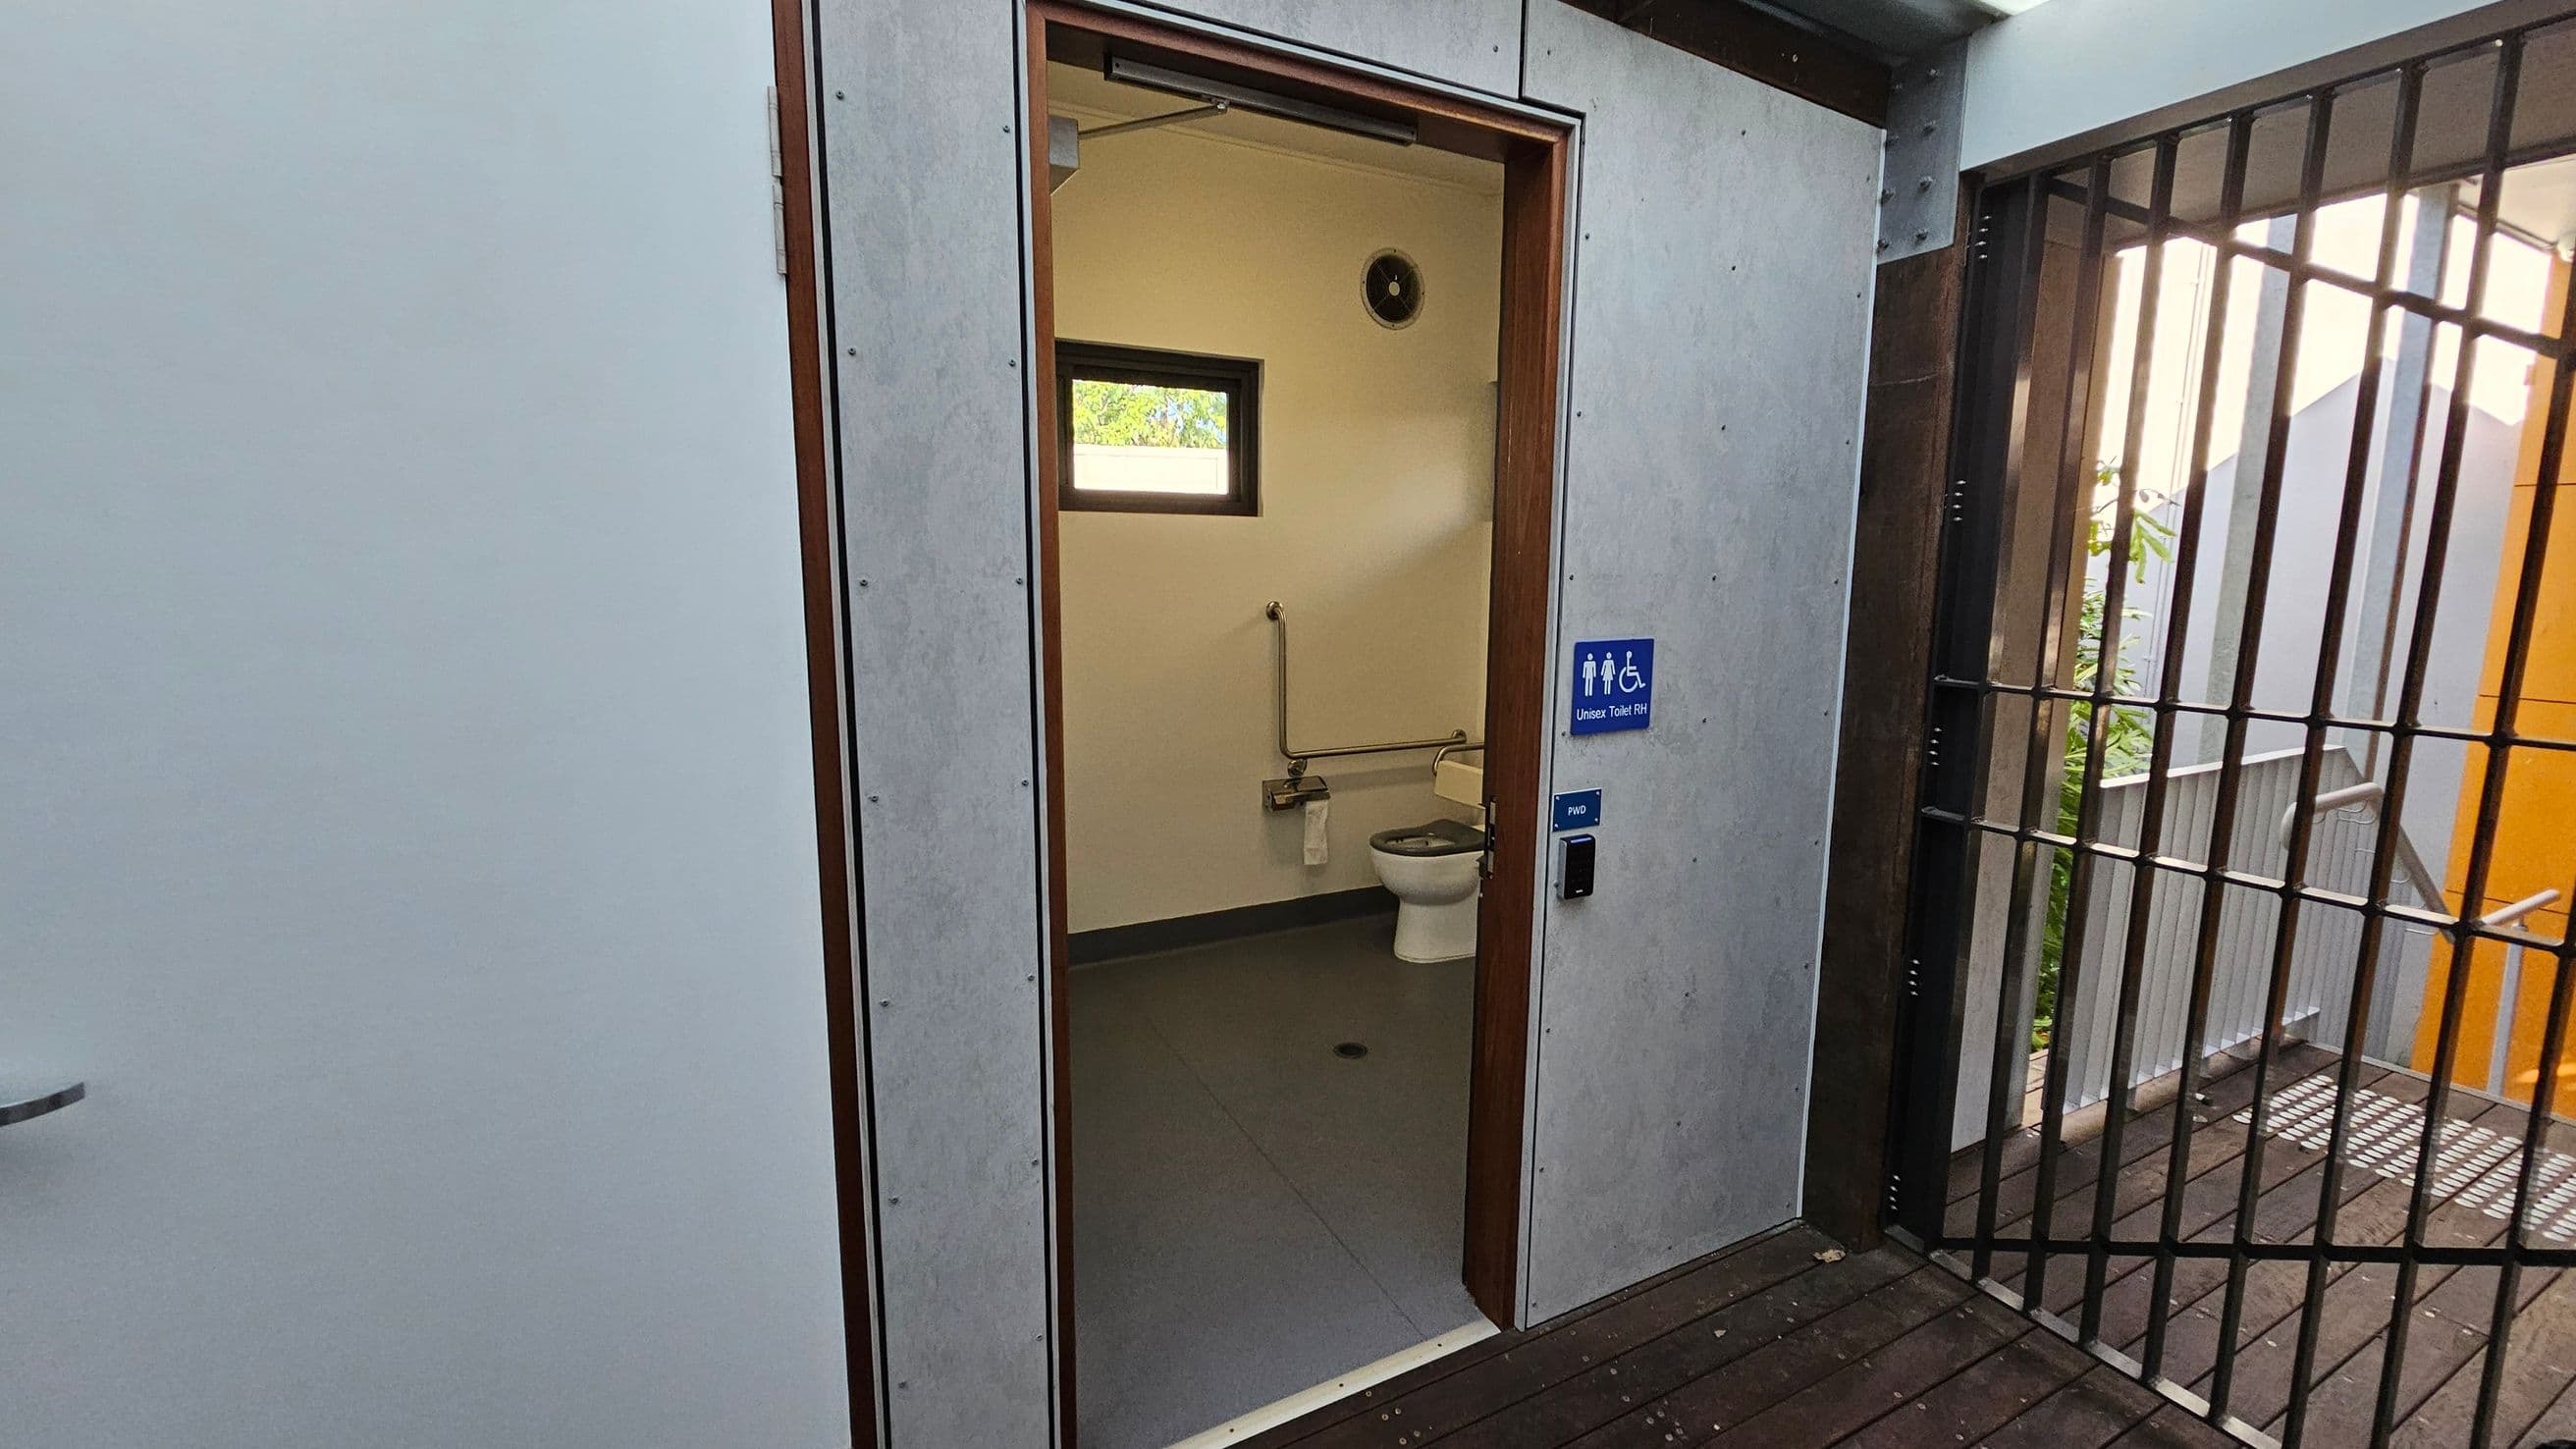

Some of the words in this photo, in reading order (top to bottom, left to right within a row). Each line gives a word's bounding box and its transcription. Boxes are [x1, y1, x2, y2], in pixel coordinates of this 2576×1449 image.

[1577, 708, 1606, 721] Unisex
[1609, 705, 1632, 718] Toilet
[1634, 703, 1647, 716] RH
[1568, 805, 1586, 816] PWD
